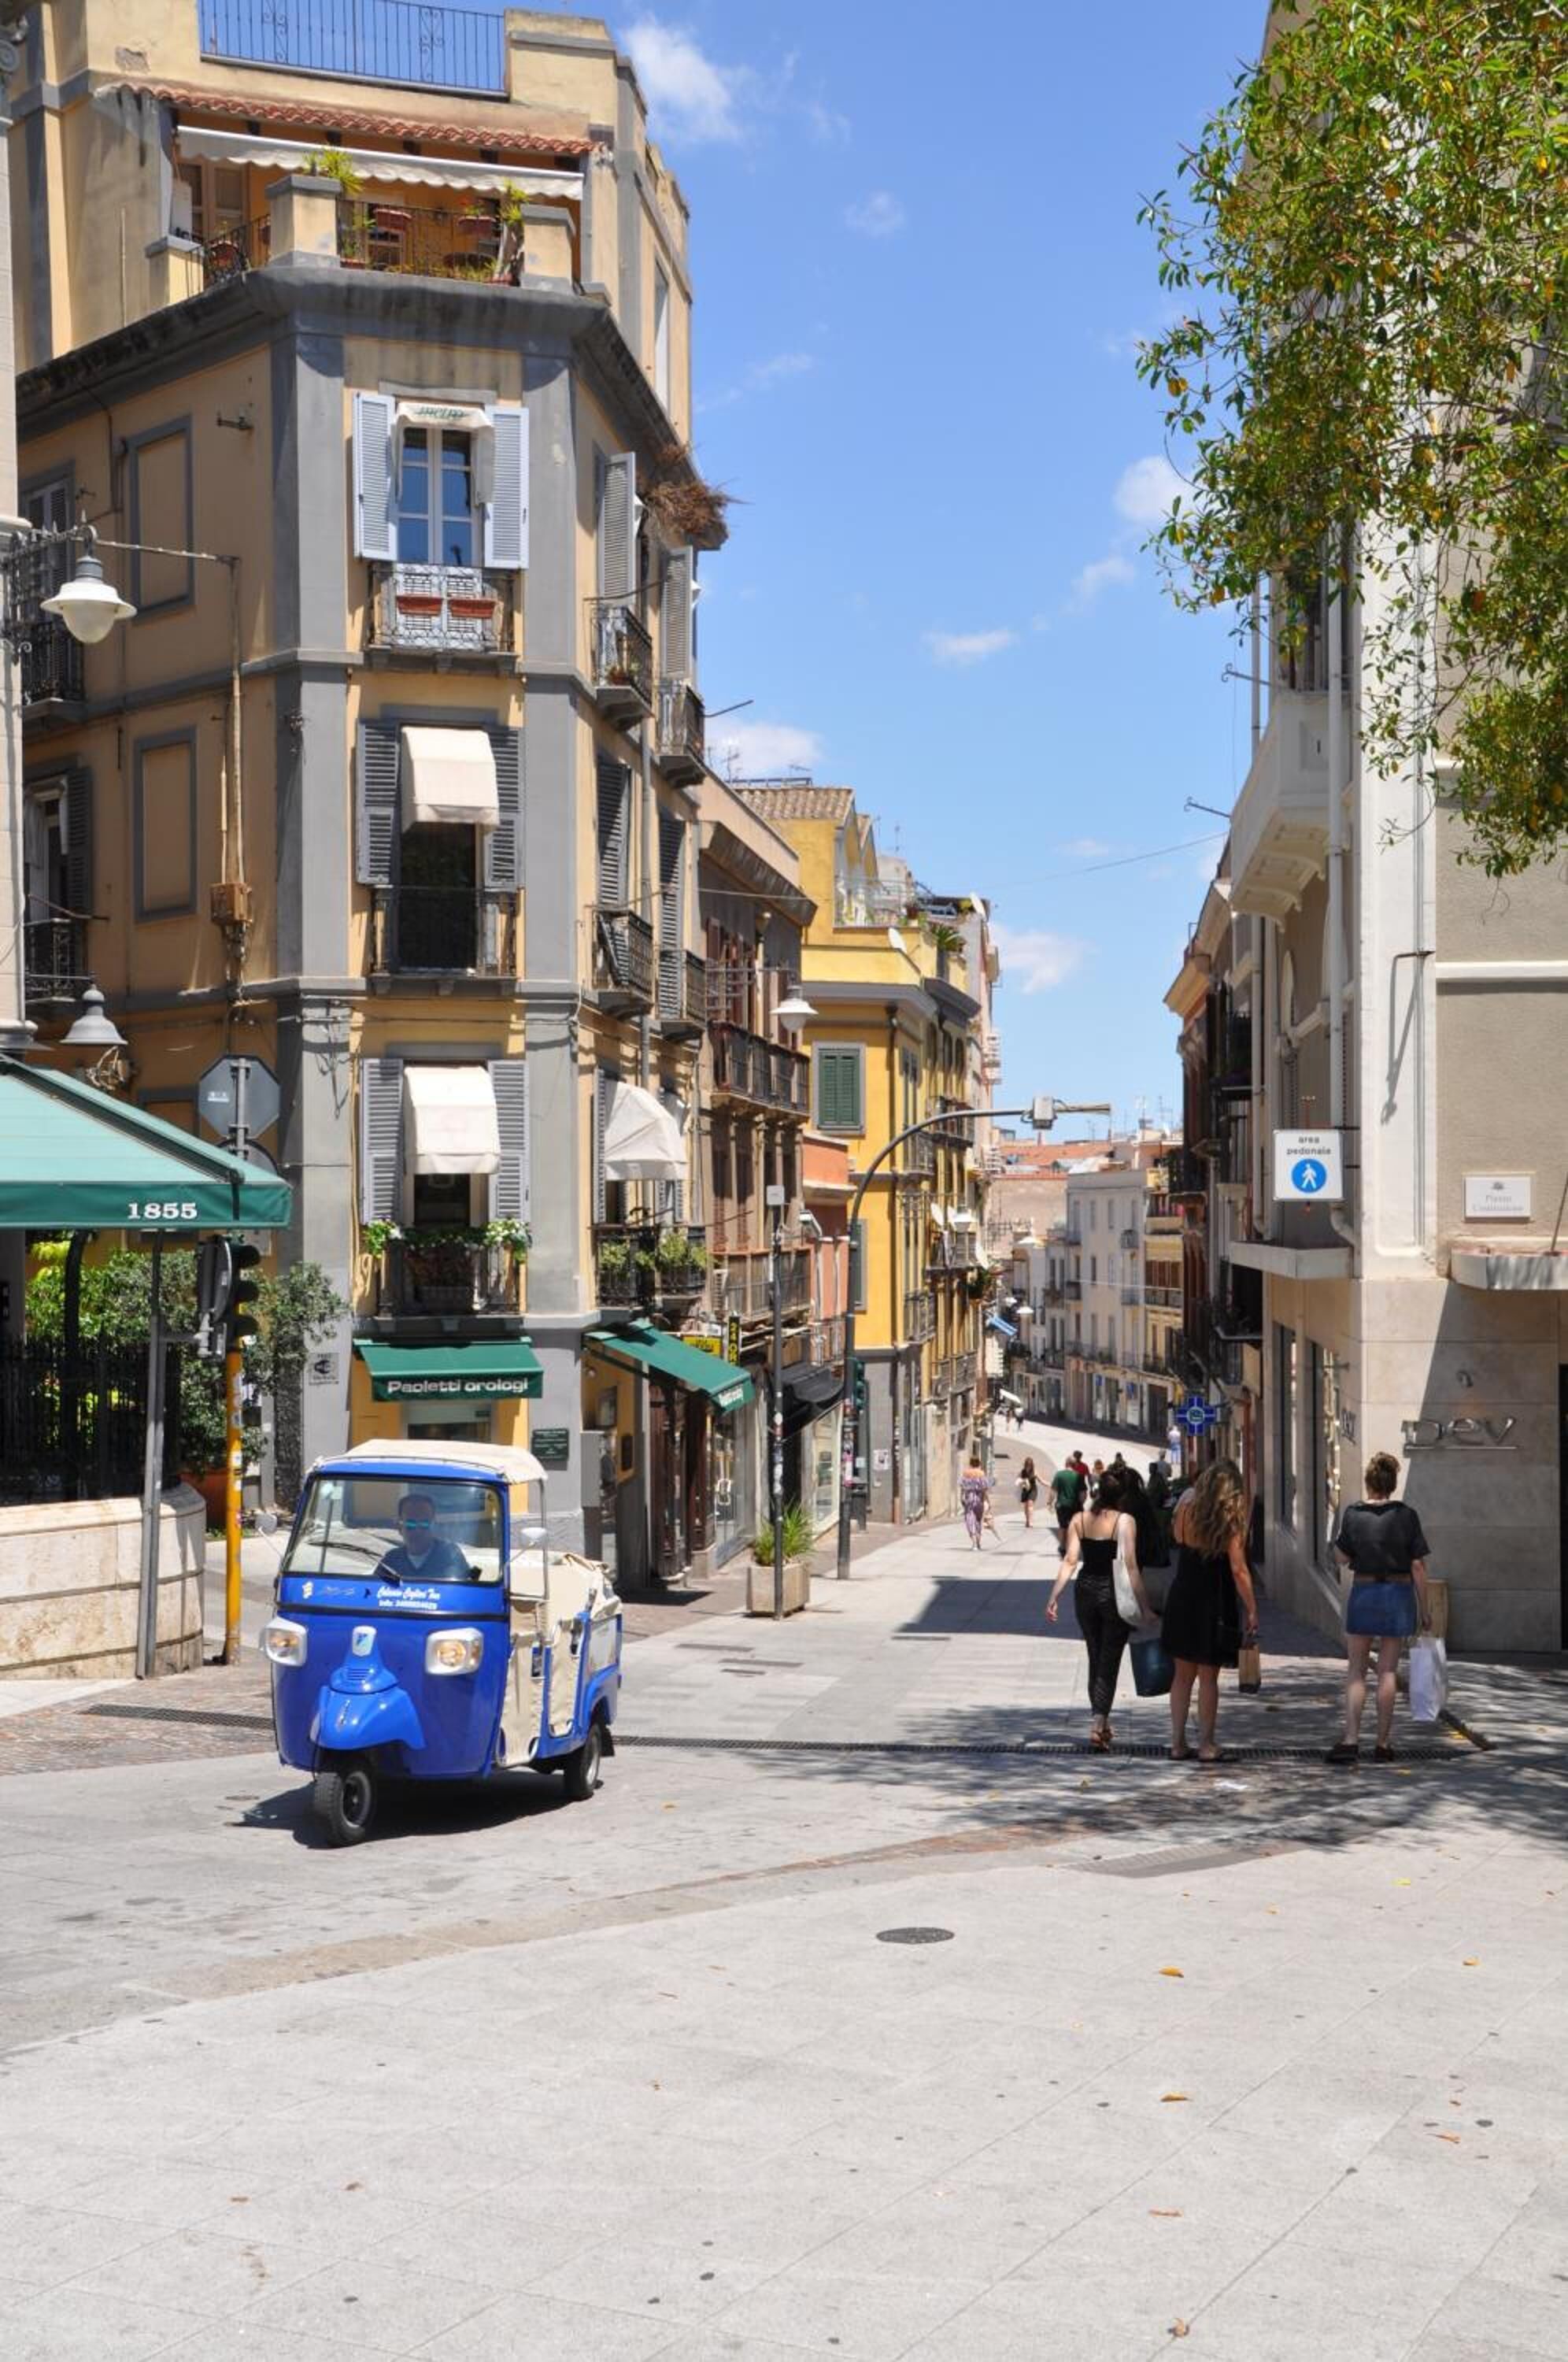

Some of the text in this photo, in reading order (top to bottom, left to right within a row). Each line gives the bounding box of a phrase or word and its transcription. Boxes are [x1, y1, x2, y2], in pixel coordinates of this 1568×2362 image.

[1286, 1147, 1331, 1156] pedonale
[128, 1202, 198, 1220] 1855
[388, 1378, 528, 1393] Paoletti orologi
